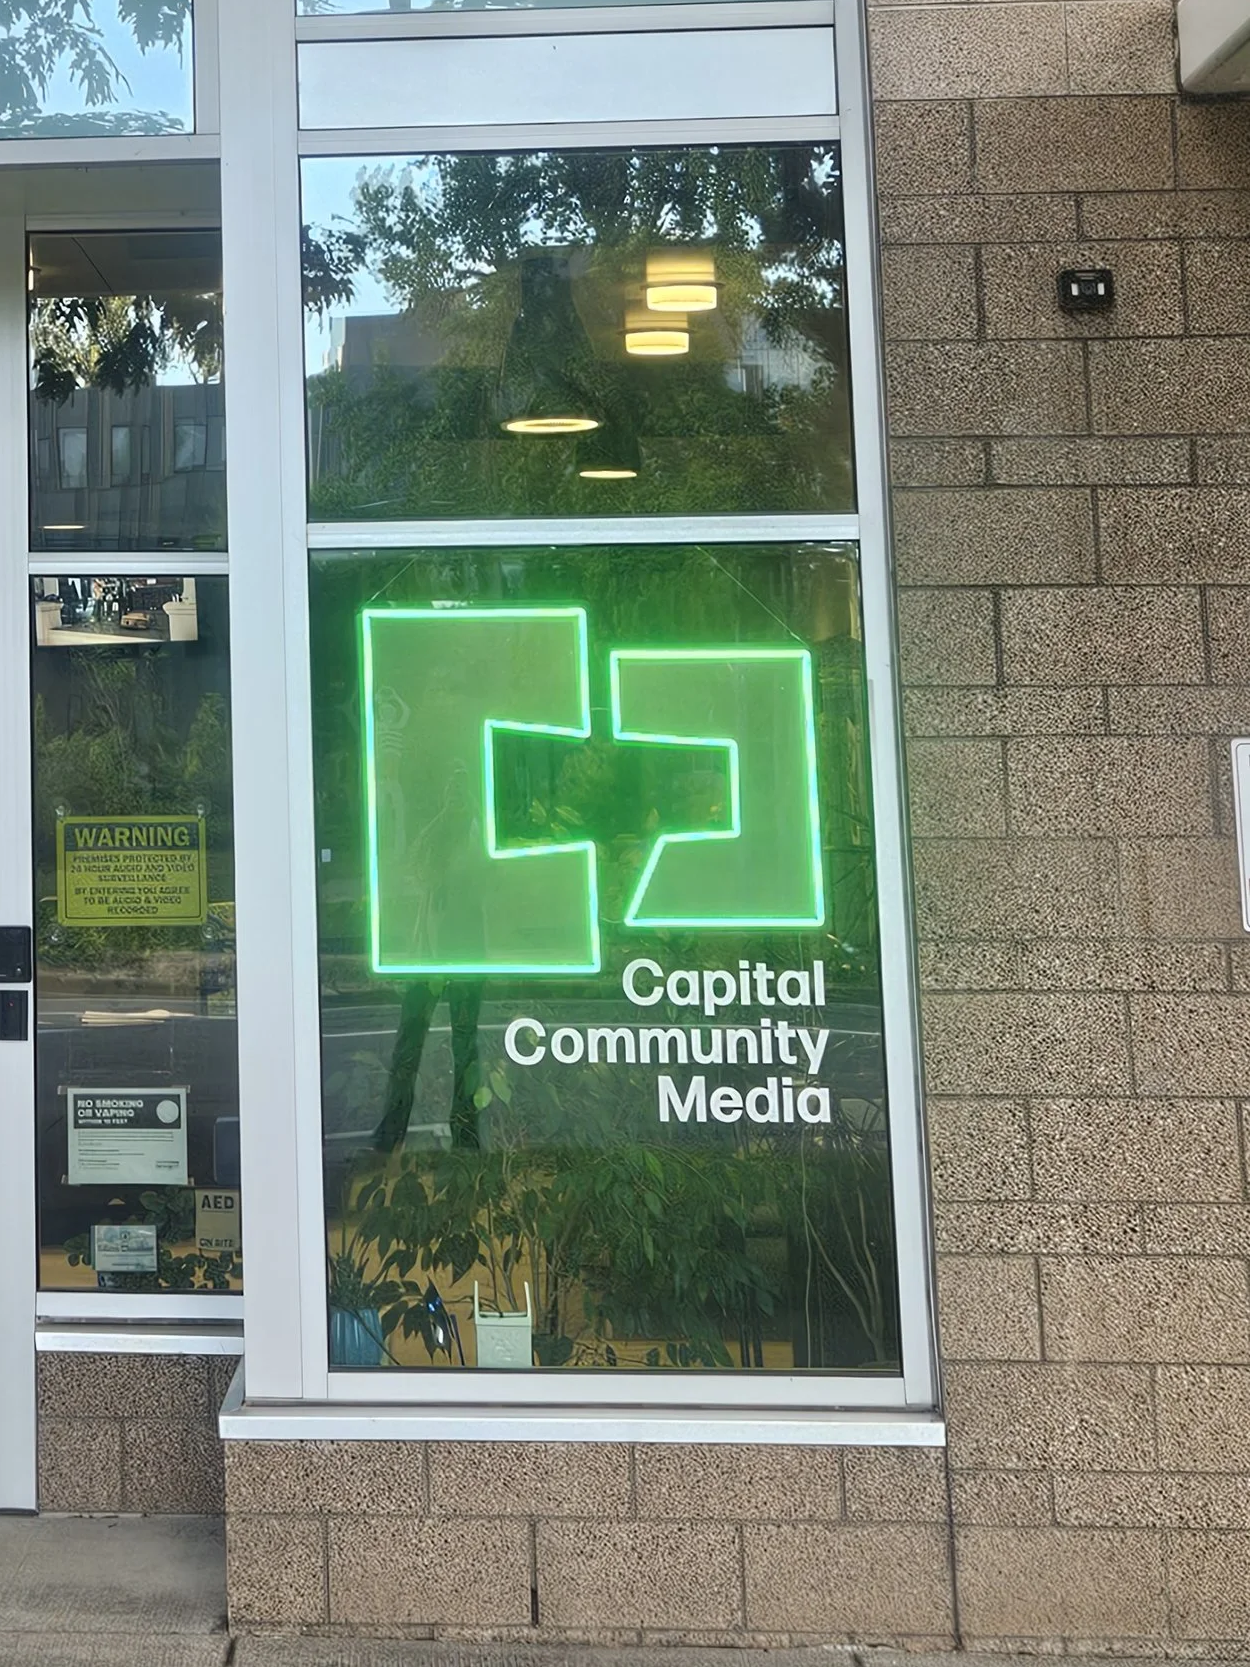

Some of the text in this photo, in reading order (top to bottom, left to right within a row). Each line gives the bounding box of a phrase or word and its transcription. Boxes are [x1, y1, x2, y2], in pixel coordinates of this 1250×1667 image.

[75, 827, 190, 847] WARNING
[73, 855, 120, 863] PREMISES
[123, 854, 177, 862] PROTECTED
[113, 864, 142, 872] AUDIO
[145, 864, 165, 872] AND
[108, 906, 158, 914] RECORDED
[622, 958, 826, 1016] Capital
[504, 1018, 829, 1074] Community
[77, 1100, 93, 1108] NO
[658, 1076, 831, 1123] Media
[78, 1109, 135, 1117] OR VAPING
[201, 1195, 234, 1209] AED
